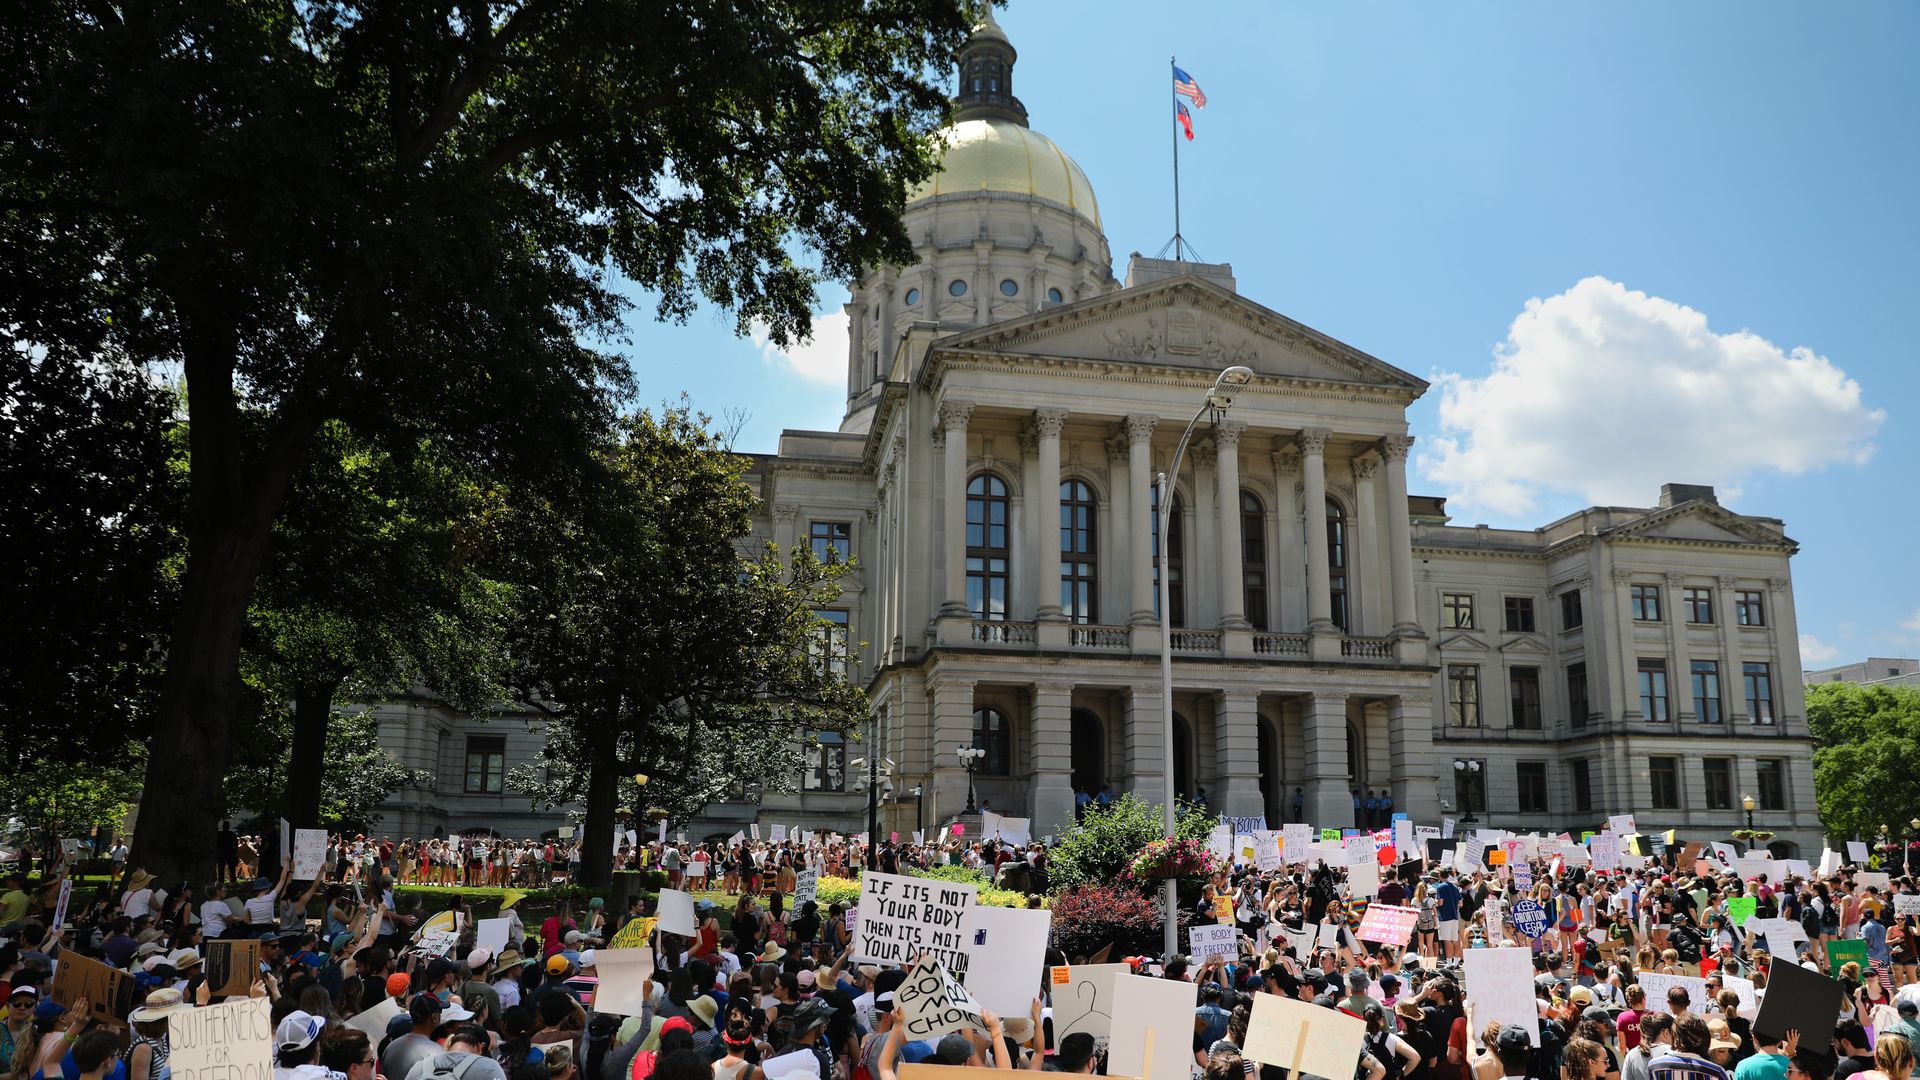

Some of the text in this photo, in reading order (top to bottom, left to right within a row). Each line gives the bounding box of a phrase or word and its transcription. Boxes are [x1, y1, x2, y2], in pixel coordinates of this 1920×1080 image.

[1237, 816, 1262, 832] BODY
[869, 878, 969, 908] IF ITS NOT
[877, 897, 964, 930] YOUR BODY
[1516, 900, 1537, 911] KEEP
[1514, 910, 1547, 924] ABORTION
[865, 919, 961, 950] THEN ITS NOT
[1194, 929, 1231, 942] MY BODY
[1520, 921, 1547, 934] LEGAL
[862, 934, 902, 961] YOUR
[1192, 943, 1236, 956] MY FREEDOM
[914, 961, 941, 979] M
[900, 976, 945, 1002] BO
[1641, 975, 1666, 993] HER
[919, 995, 949, 1013] M
[170, 998, 270, 1050] SOUTHERNERS
[206, 1047, 230, 1064] FOR
